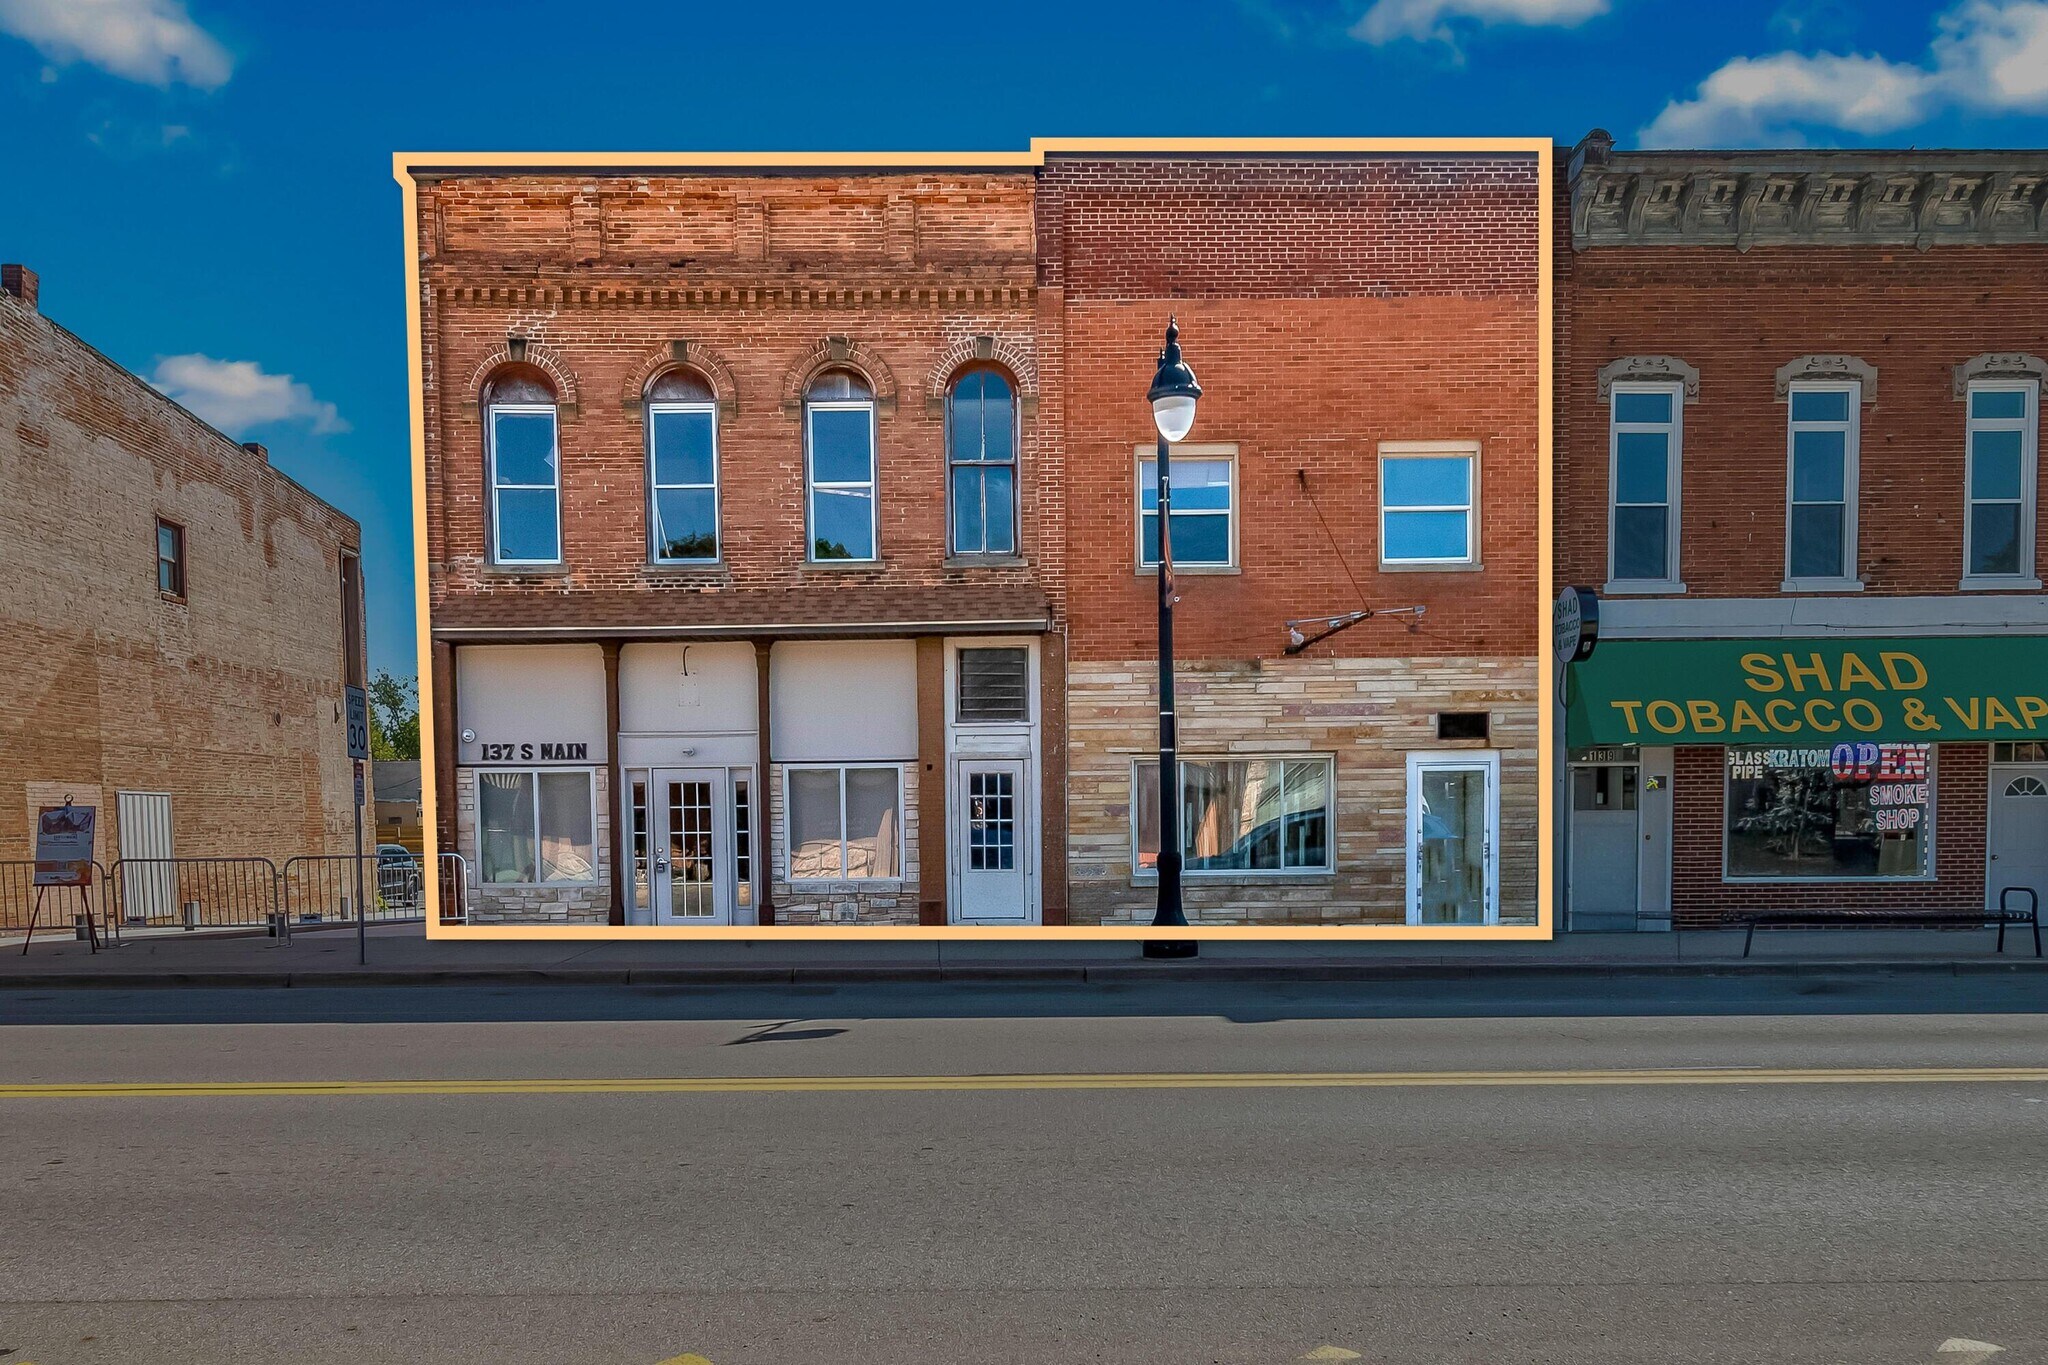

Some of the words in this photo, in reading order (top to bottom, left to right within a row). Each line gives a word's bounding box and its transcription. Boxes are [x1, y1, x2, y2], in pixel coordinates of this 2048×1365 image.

[1557, 596, 1578, 619] SHAD
[1739, 651, 1929, 693] SHAD
[348, 694, 364, 708] SPEED
[350, 708, 364, 720] LIMIT
[1610, 698, 1884, 734] TOBACCO
[1902, 697, 1942, 731] &
[1943, 696, 2048, 730] VAP
[349, 723, 366, 751] 30
[481, 743, 515, 761] 137
[520, 743, 534, 761] S
[540, 743, 587, 760] MAIN
[1589, 750, 1614, 761] 139
[1728, 751, 1770, 766] GLASS
[1768, 749, 1830, 768] KRATOM
[1832, 743, 1930, 780] OPEN
[1732, 765, 1763, 779] PIPE
[1869, 783, 1928, 806] SMOKE
[1876, 808, 1920, 830] SHOP
